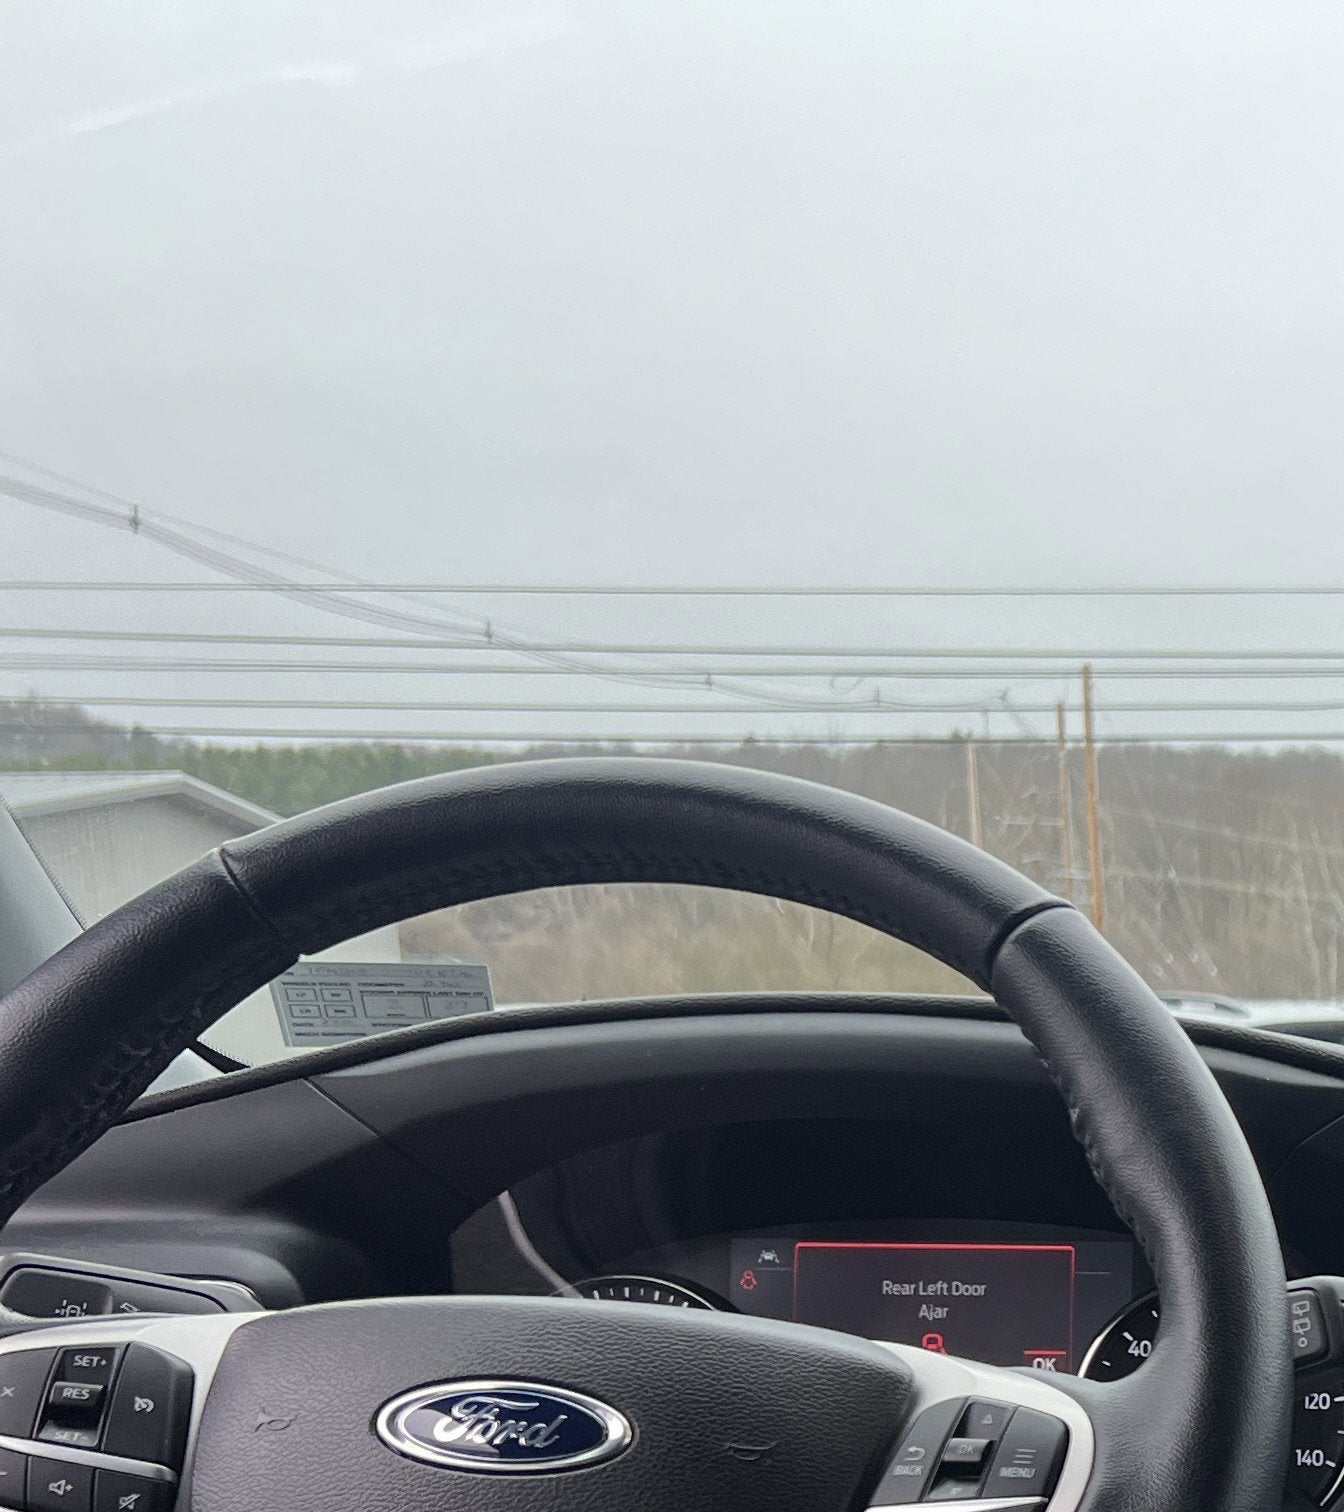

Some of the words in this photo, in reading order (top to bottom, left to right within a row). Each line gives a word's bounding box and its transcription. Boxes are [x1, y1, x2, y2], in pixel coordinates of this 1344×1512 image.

[882, 1280, 915, 1296] Rear
[918, 1281, 949, 1296] Left
[951, 1281, 987, 1297] Door
[918, 1304, 949, 1321] Ajar
[1127, 1339, 1152, 1358] 40
[1031, 1357, 1057, 1373] OK
[62, 1386, 90, 1400] RES
[1304, 1392, 1331, 1411] 120
[433, 1396, 569, 1449] Ford
[1295, 1449, 1325, 1468] 140
[893, 1464, 925, 1477] BACK
[999, 1466, 1037, 1479] MENU
